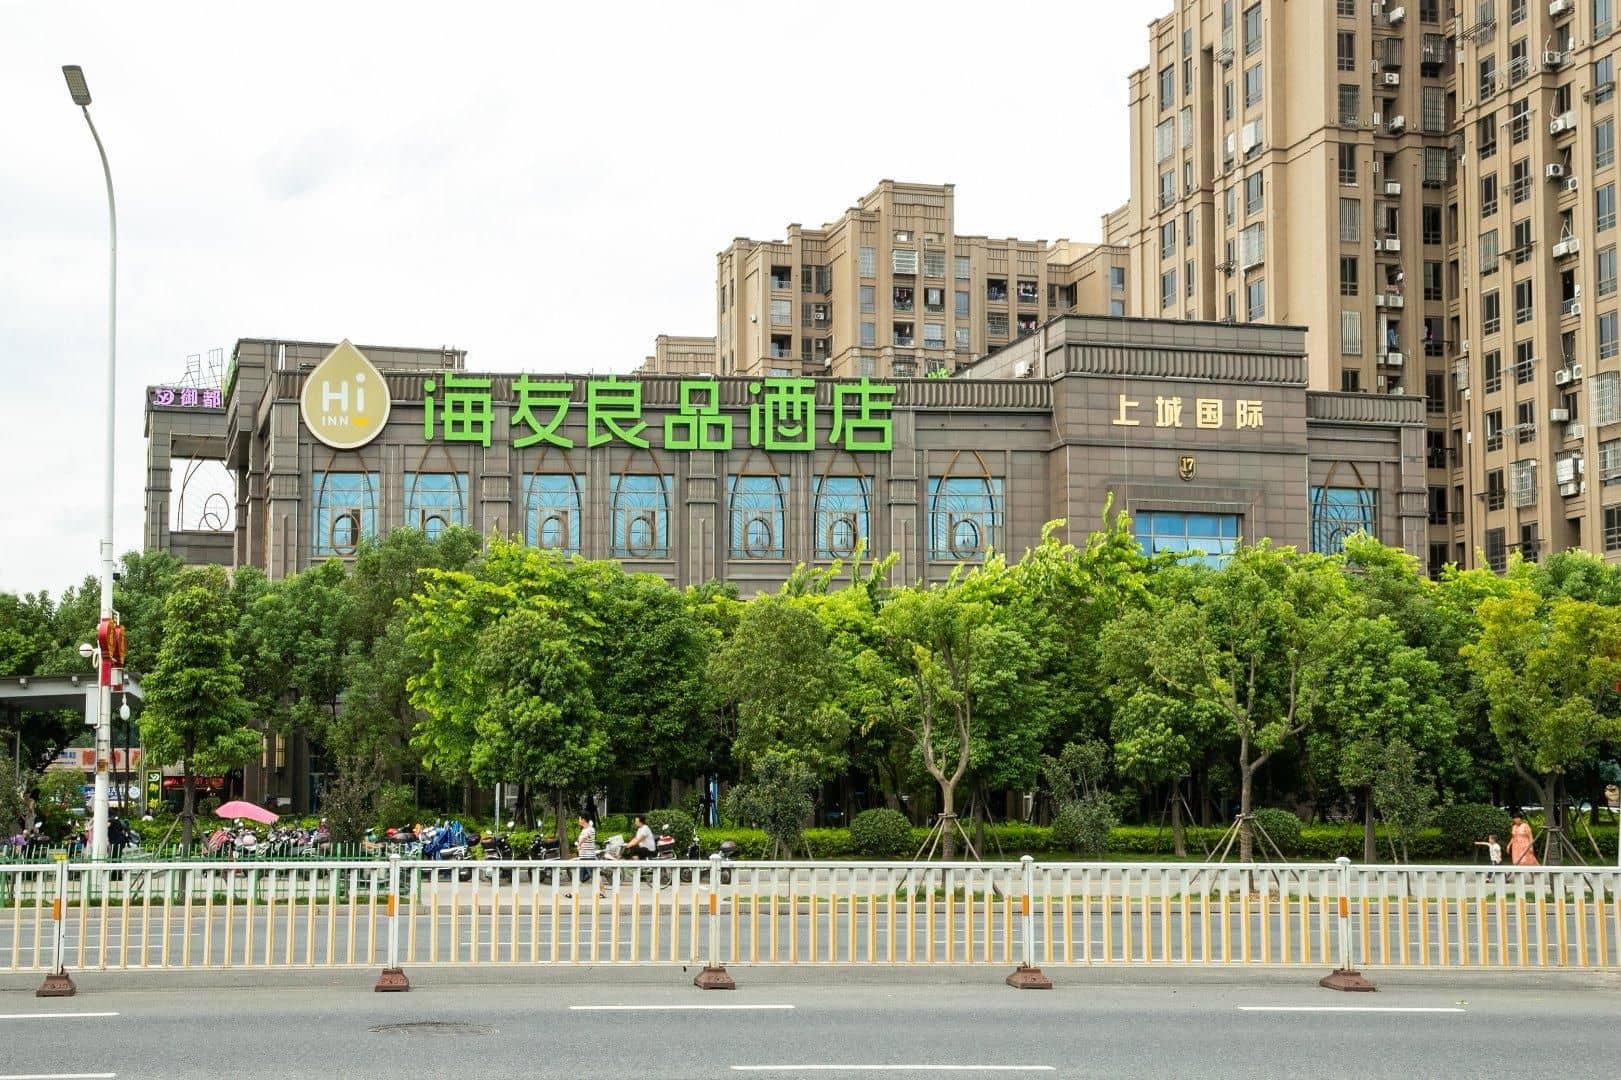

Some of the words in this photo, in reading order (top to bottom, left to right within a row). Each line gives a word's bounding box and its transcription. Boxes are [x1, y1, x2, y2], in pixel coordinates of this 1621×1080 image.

[322, 372, 366, 412] Hi
[321, 415, 349, 426] INN
[424, 372, 897, 451] 海友良品酒店
[1112, 394, 1264, 430] 上城国际
[1181, 457, 1195, 472] 17
